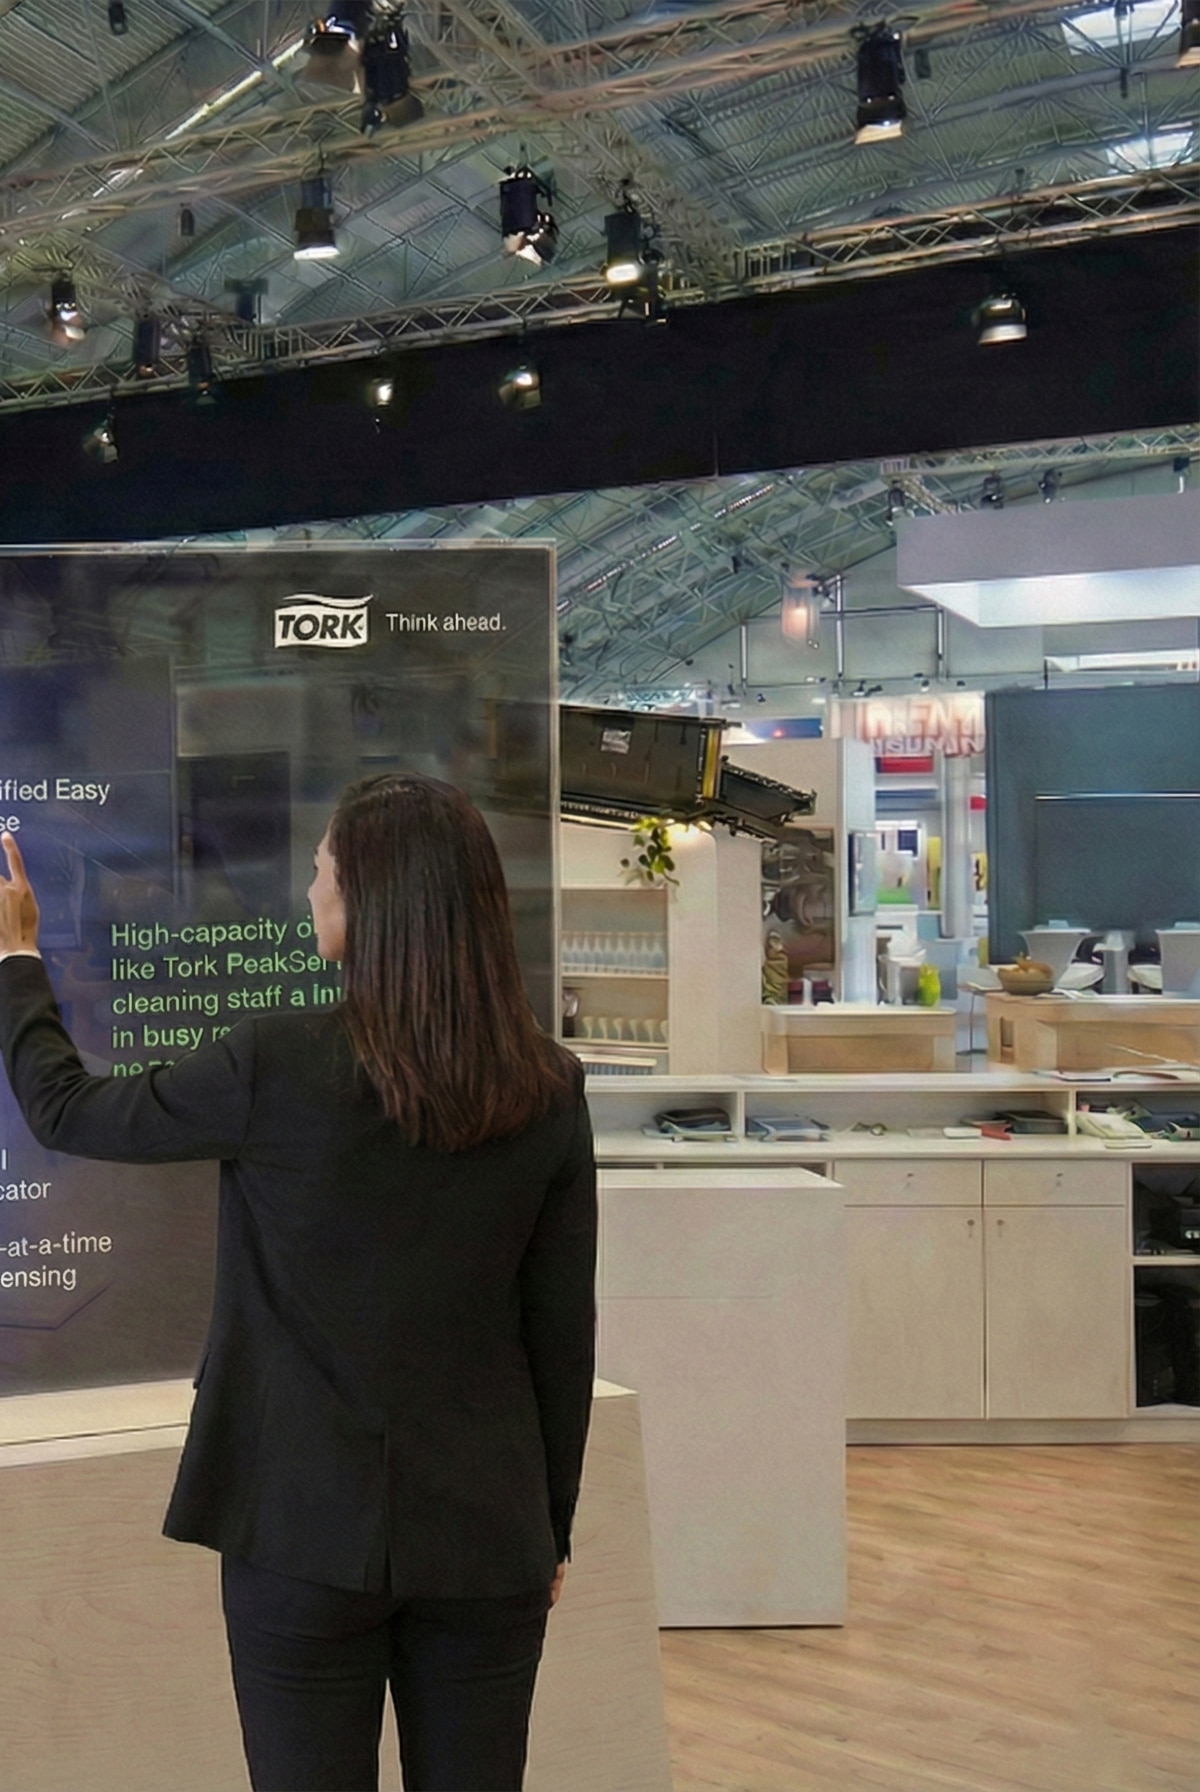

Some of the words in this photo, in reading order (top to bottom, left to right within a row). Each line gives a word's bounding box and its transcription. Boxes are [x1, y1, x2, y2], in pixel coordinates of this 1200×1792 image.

[278, 614, 364, 640] TORK
[385, 613, 439, 632] Think
[443, 613, 507, 632] ahead.
[55, 778, 111, 805] Easy
[111, 917, 288, 951] High-capacity
[112, 958, 155, 981] like
[163, 954, 218, 978] Tork
[112, 988, 219, 1016] cleaning
[227, 984, 282, 1009] staff
[289, 990, 306, 1007] a
[112, 1025, 134, 1049] in
[143, 1024, 204, 1051] busy
